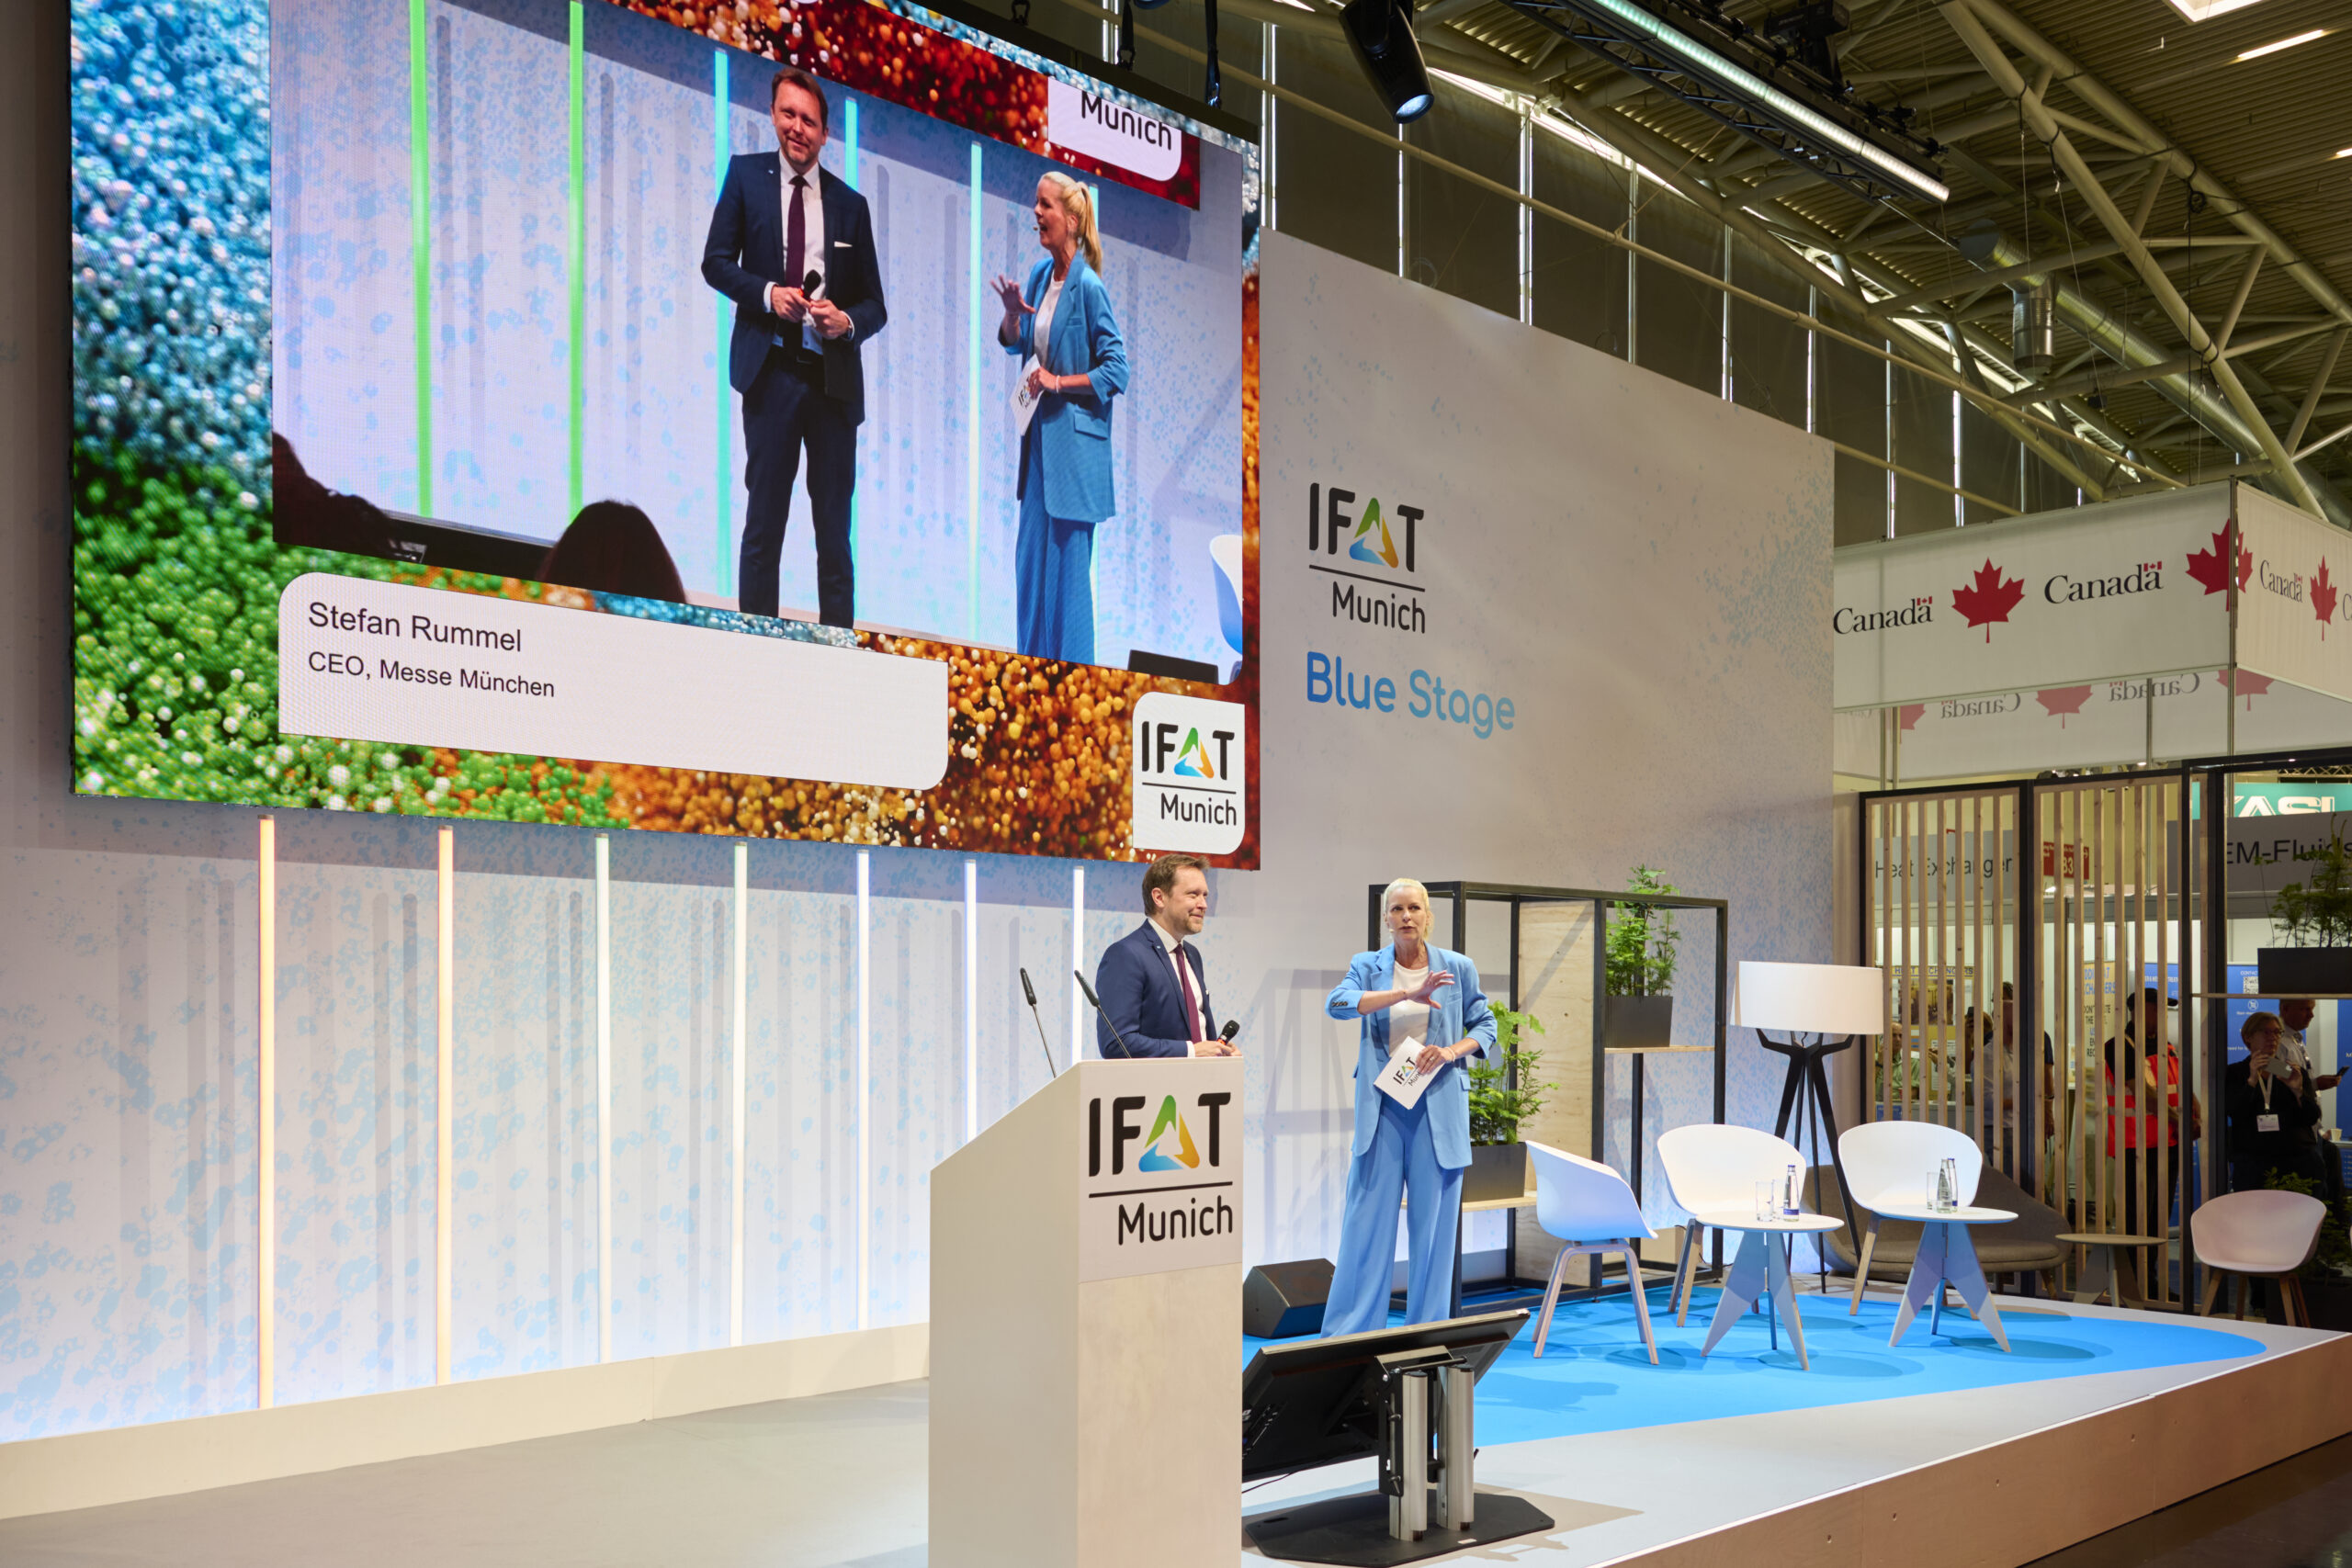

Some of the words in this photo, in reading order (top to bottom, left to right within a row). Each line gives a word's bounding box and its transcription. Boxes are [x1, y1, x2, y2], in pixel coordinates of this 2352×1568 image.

[1081, 90, 1171, 151] Munich
[1309, 482, 1424, 572] IFAT
[2044, 561, 2164, 604] Canada
[2260, 559, 2302, 603] Canada
[309, 602, 400, 637] Stefan
[412, 615, 521, 651] Rummel
[1332, 581, 1425, 634] Munich
[1833, 596, 1933, 635] Canada
[308, 651, 370, 681] CEO,
[379, 659, 452, 686] Messe
[460, 669, 555, 697] München
[1306, 651, 1396, 713] Blue
[1408, 669, 1515, 739] Stage
[1141, 721, 1235, 781] IFAT
[1160, 794, 1237, 826] Munich
[1089, 1092, 1231, 1177] IFAT
[1118, 1195, 1233, 1246] Munich
